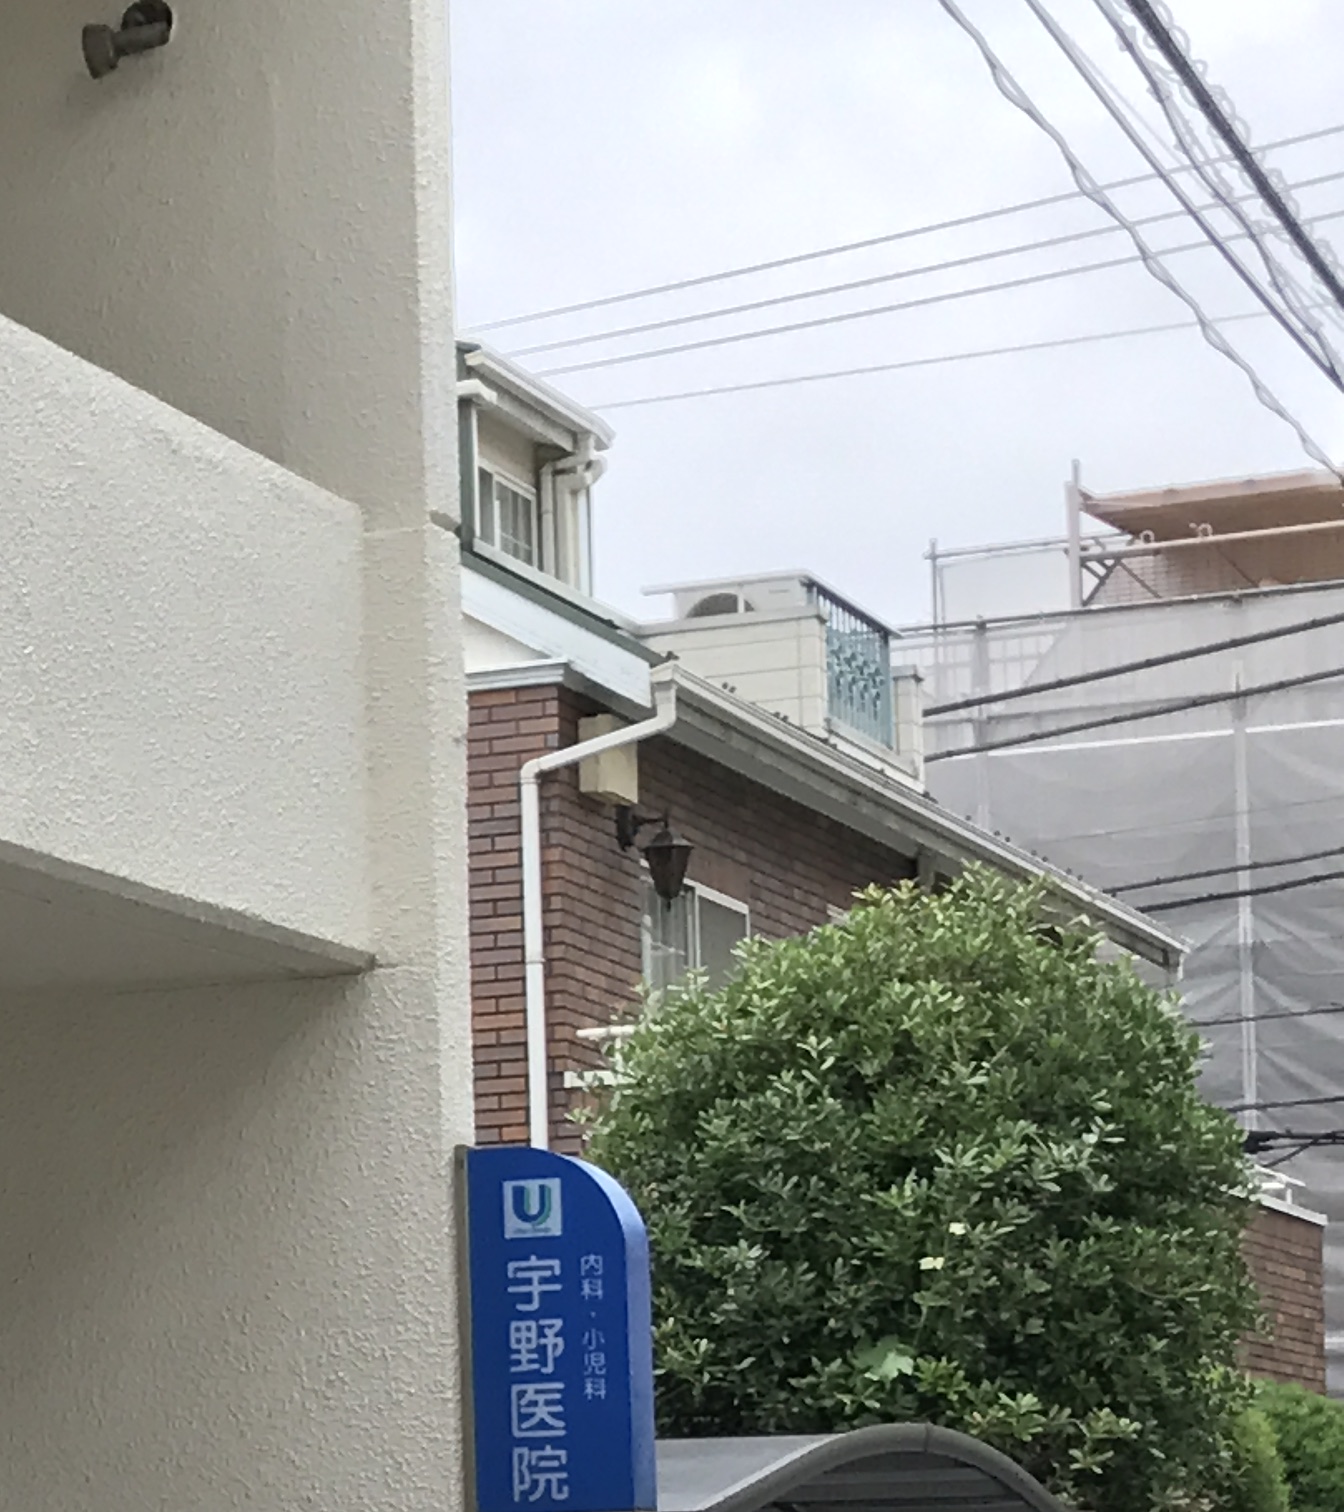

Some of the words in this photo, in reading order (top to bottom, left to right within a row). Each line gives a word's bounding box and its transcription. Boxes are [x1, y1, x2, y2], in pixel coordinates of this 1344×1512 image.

[512, 1184, 552, 1226] U
[507, 1254, 569, 1502] 宇野医院
